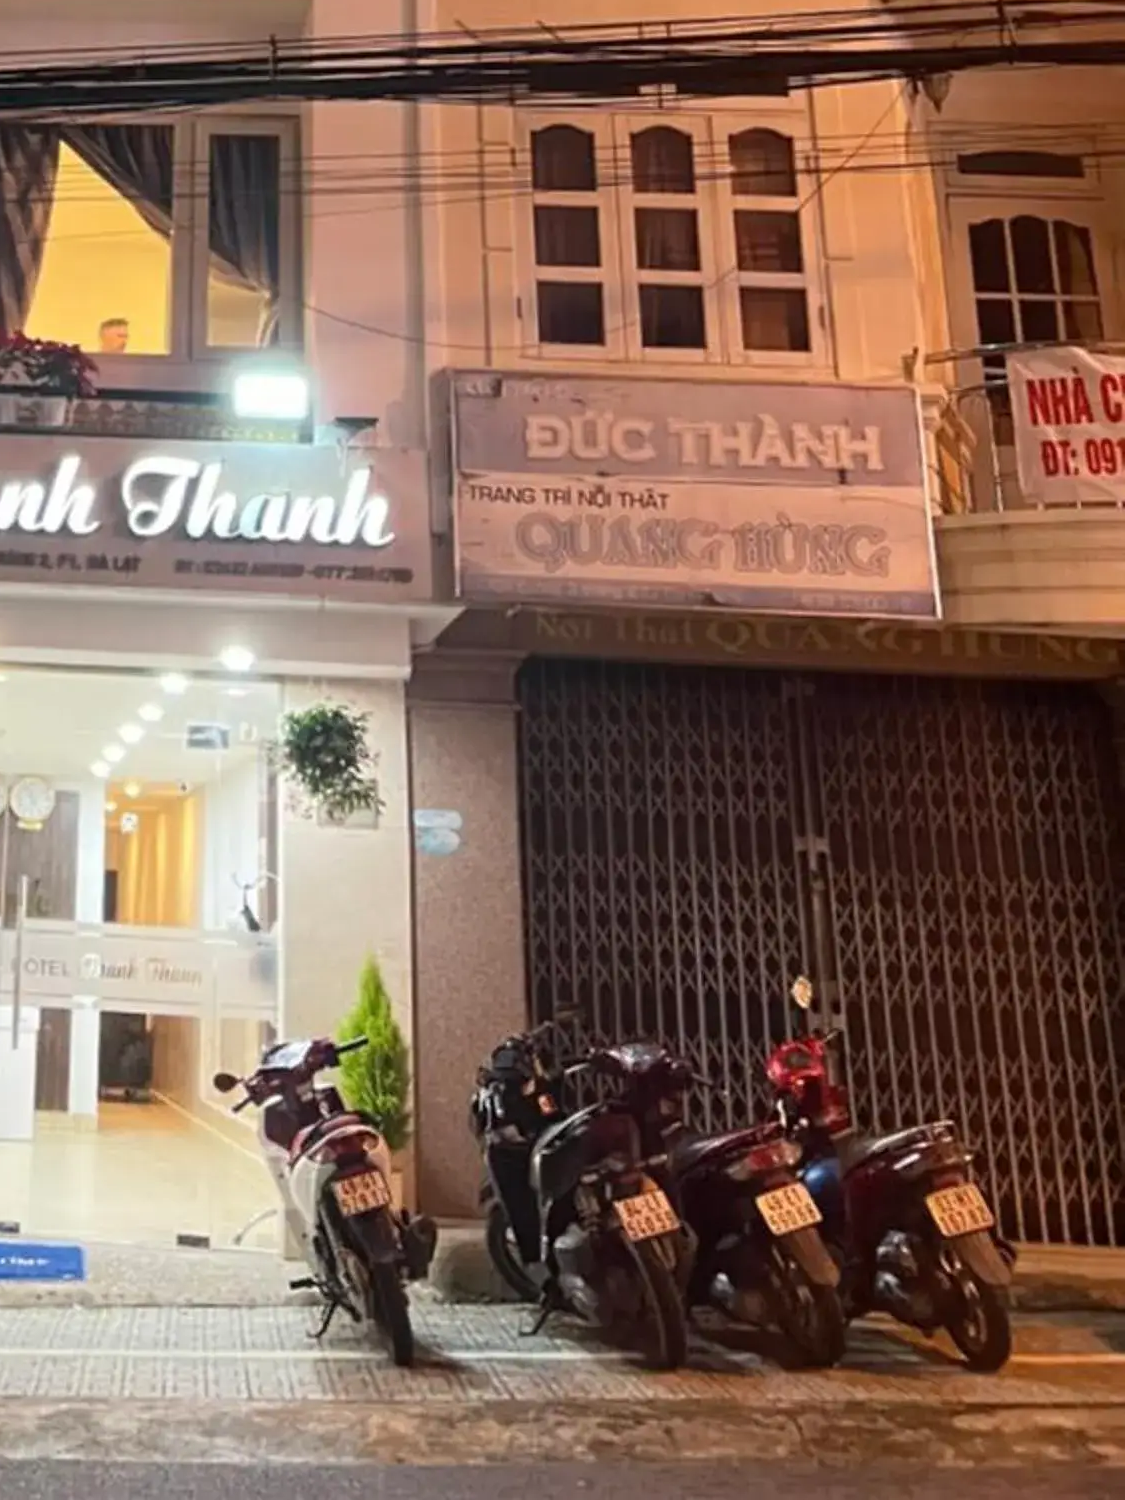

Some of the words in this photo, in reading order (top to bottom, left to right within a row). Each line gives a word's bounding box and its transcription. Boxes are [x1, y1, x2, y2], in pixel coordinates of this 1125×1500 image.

[1026, 366, 1093, 426] NHÀ
[1100, 373, 1125, 423] C
[525, 409, 655, 463] ĐỨC
[668, 414, 885, 470] THÀNH
[1041, 440, 1079, 476] ĐT:
[121, 456, 394, 549] Thanh
[469, 485, 536, 505] TRANG
[516, 512, 724, 573] QUANG
